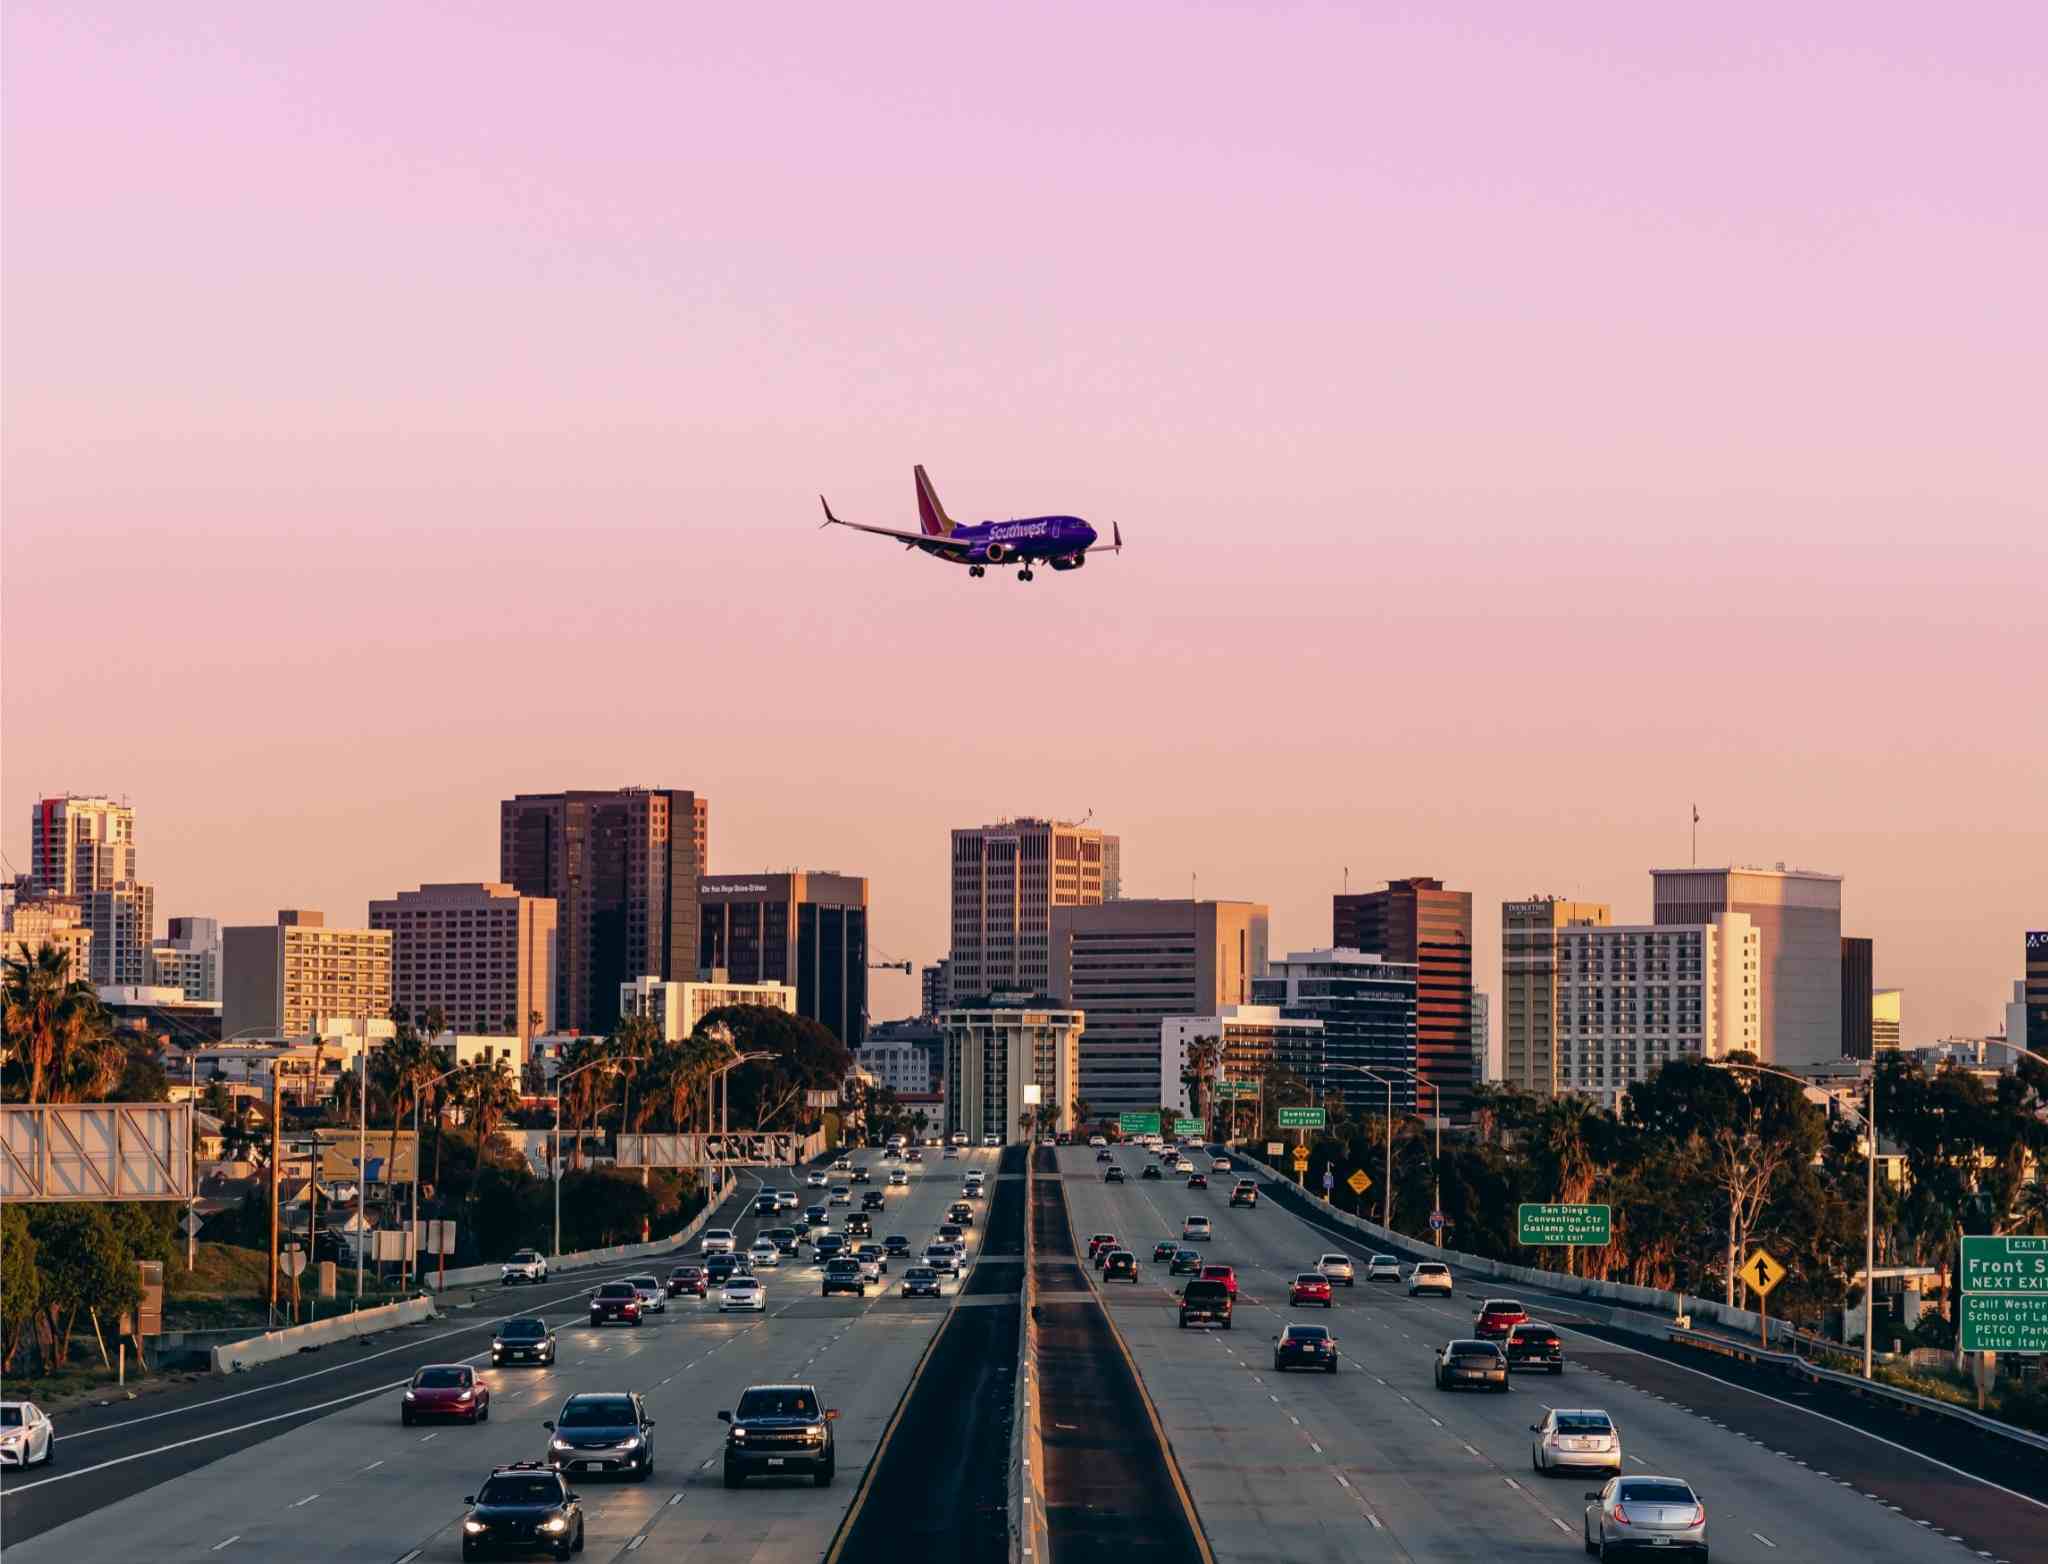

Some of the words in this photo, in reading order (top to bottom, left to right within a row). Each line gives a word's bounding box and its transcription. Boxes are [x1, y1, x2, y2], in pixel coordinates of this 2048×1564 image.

[989, 520, 1047, 539] Southwest
[1541, 1206, 1558, 1214] San
[1562, 1206, 1589, 1215] Diego
[1527, 1215, 1581, 1223] Convention
[1585, 1215, 1601, 1223] Ctr
[1523, 1224, 1564, 1232] Gaslamp
[1568, 1224, 1605, 1232] Quarter
[2015, 1240, 2037, 1249] EXIT
[1969, 1258, 2024, 1273] Front
[1972, 1277, 2013, 1289] NEXT
[1970, 1299, 1999, 1309] Calif
[1968, 1311, 2009, 1321] School
[2015, 1311, 2027, 1321] of
[1975, 1325, 2016, 1335] PETCO
[2021, 1325, 2048, 1335] Park
[1977, 1337, 2012, 1347] Little
[2018, 1337, 2047, 1350] Italy
